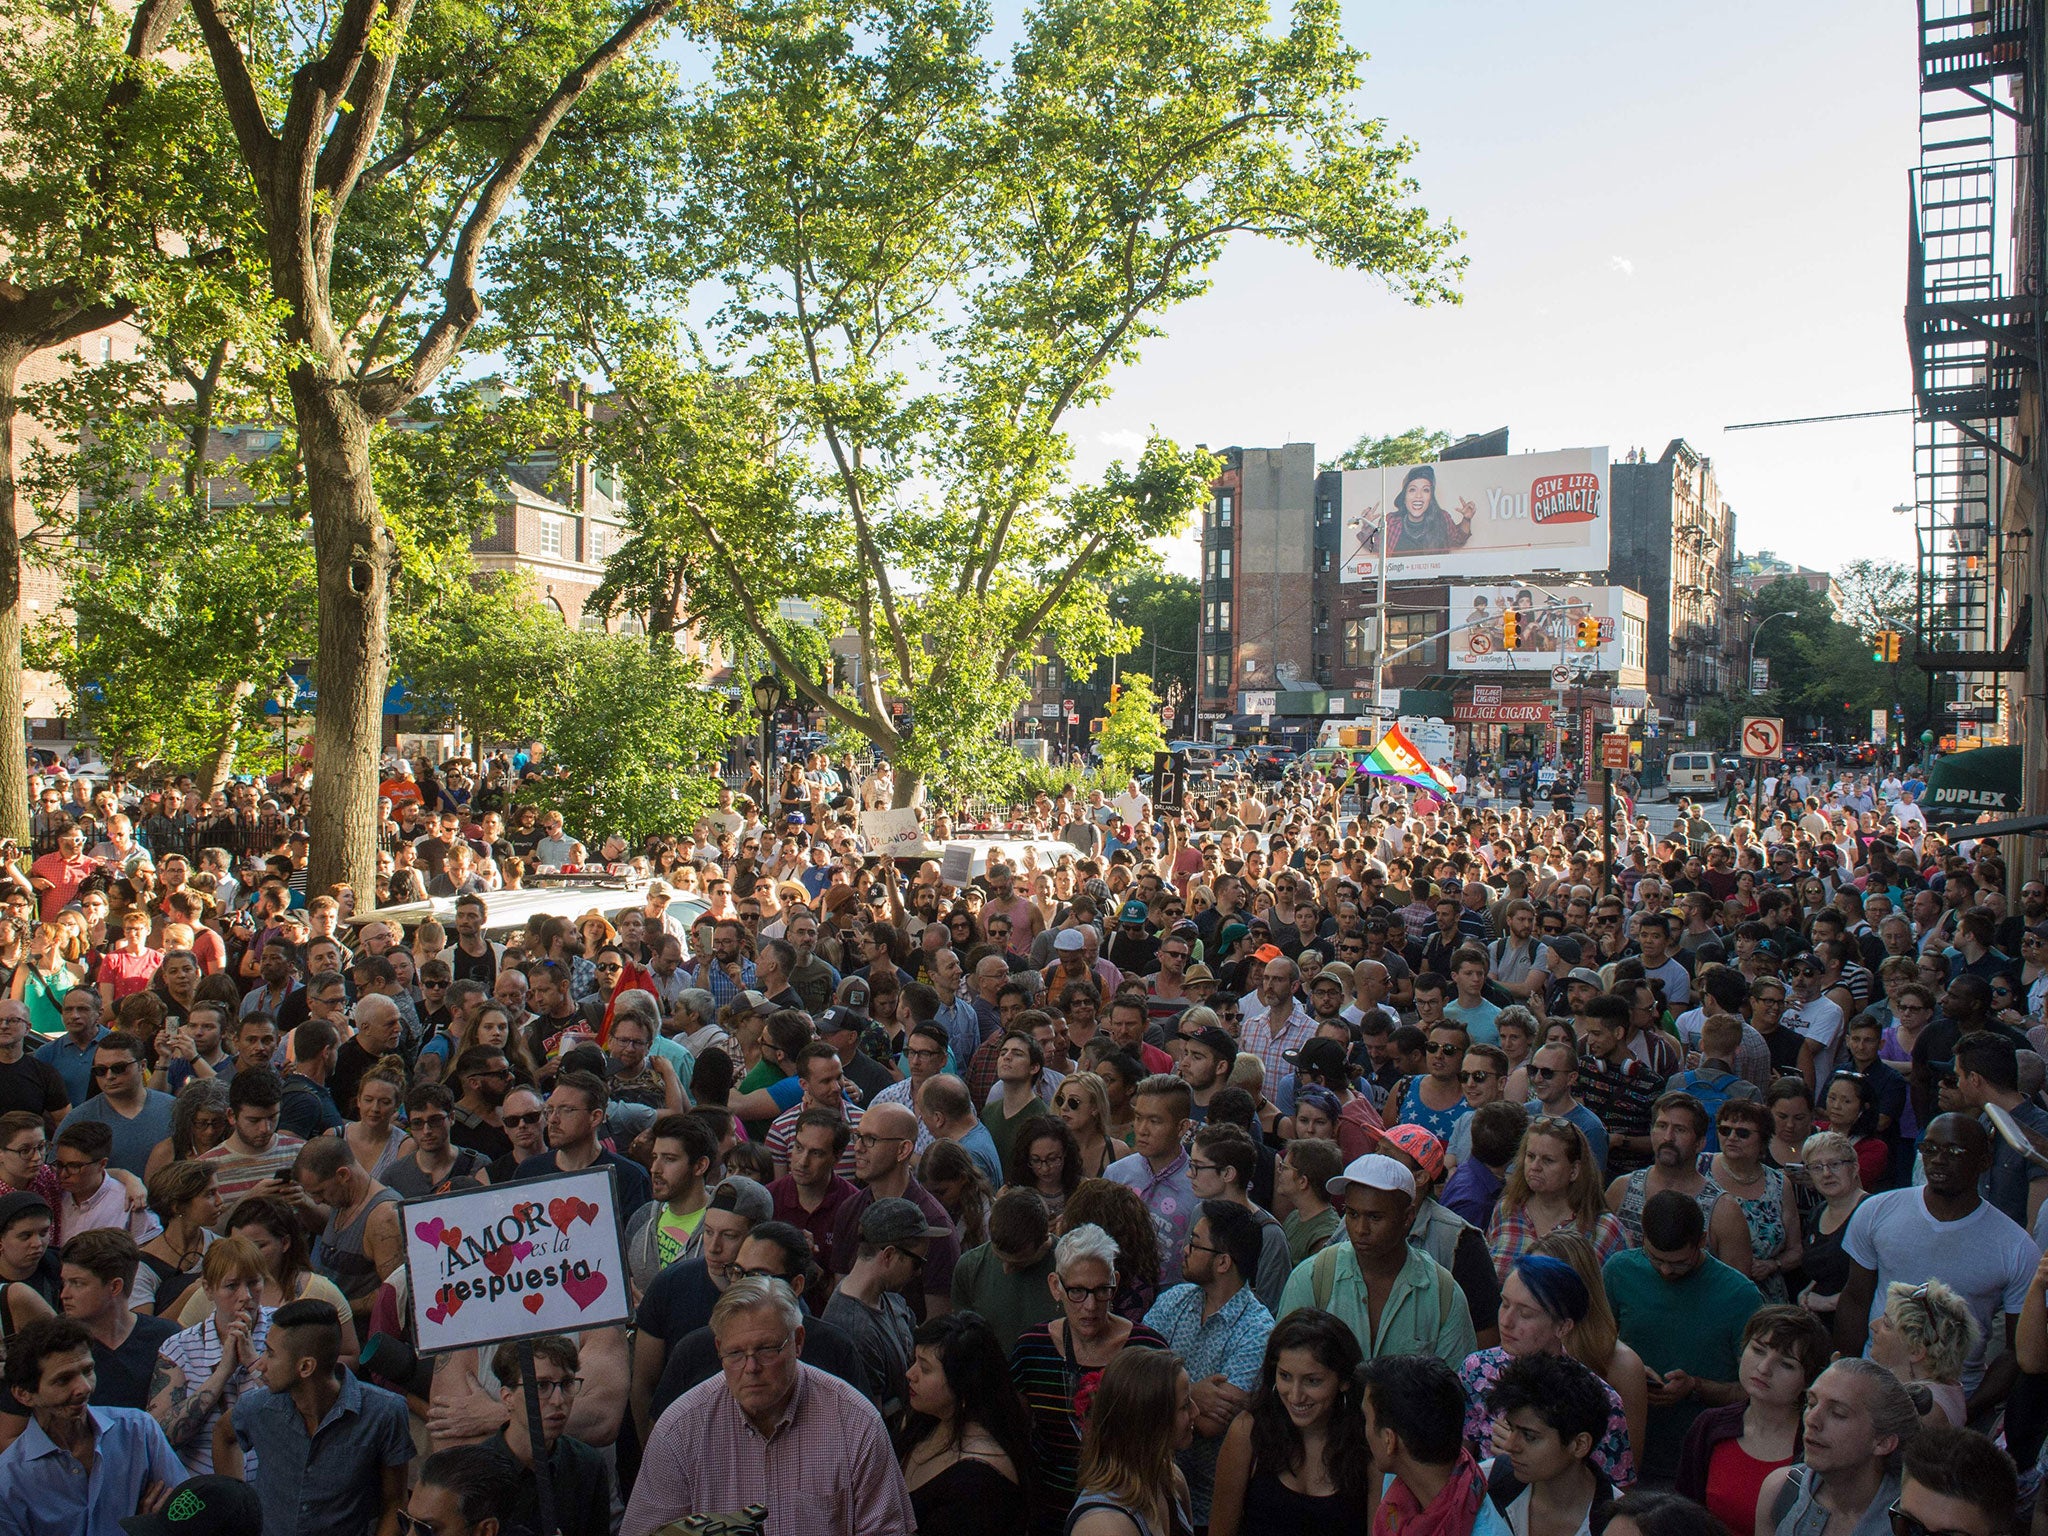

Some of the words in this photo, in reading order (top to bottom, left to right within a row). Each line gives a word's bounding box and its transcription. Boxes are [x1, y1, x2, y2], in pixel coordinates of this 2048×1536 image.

[1535, 477, 1563, 497] GIVE
[1569, 475, 1595, 488] LIFE
[1486, 487, 1529, 521] You
[1534, 488, 1602, 521] CHARACTER
[1347, 565, 1357, 575] You
[1359, 691, 1364, 699] 4
[1476, 688, 1500, 697] VILLAGE
[1476, 696, 1500, 705] CIGARS
[1453, 706, 1496, 719] VILLAGE
[1499, 706, 1543, 721] CIGARS
[1611, 738, 1627, 746] STOPPING
[1935, 788, 2007, 807] DUPLEX
[1154, 804, 1180, 812] ORLANDO
[870, 831, 918, 847] ORLANDO
[531, 1241, 548, 1258] es
[553, 1228, 573, 1254] la
